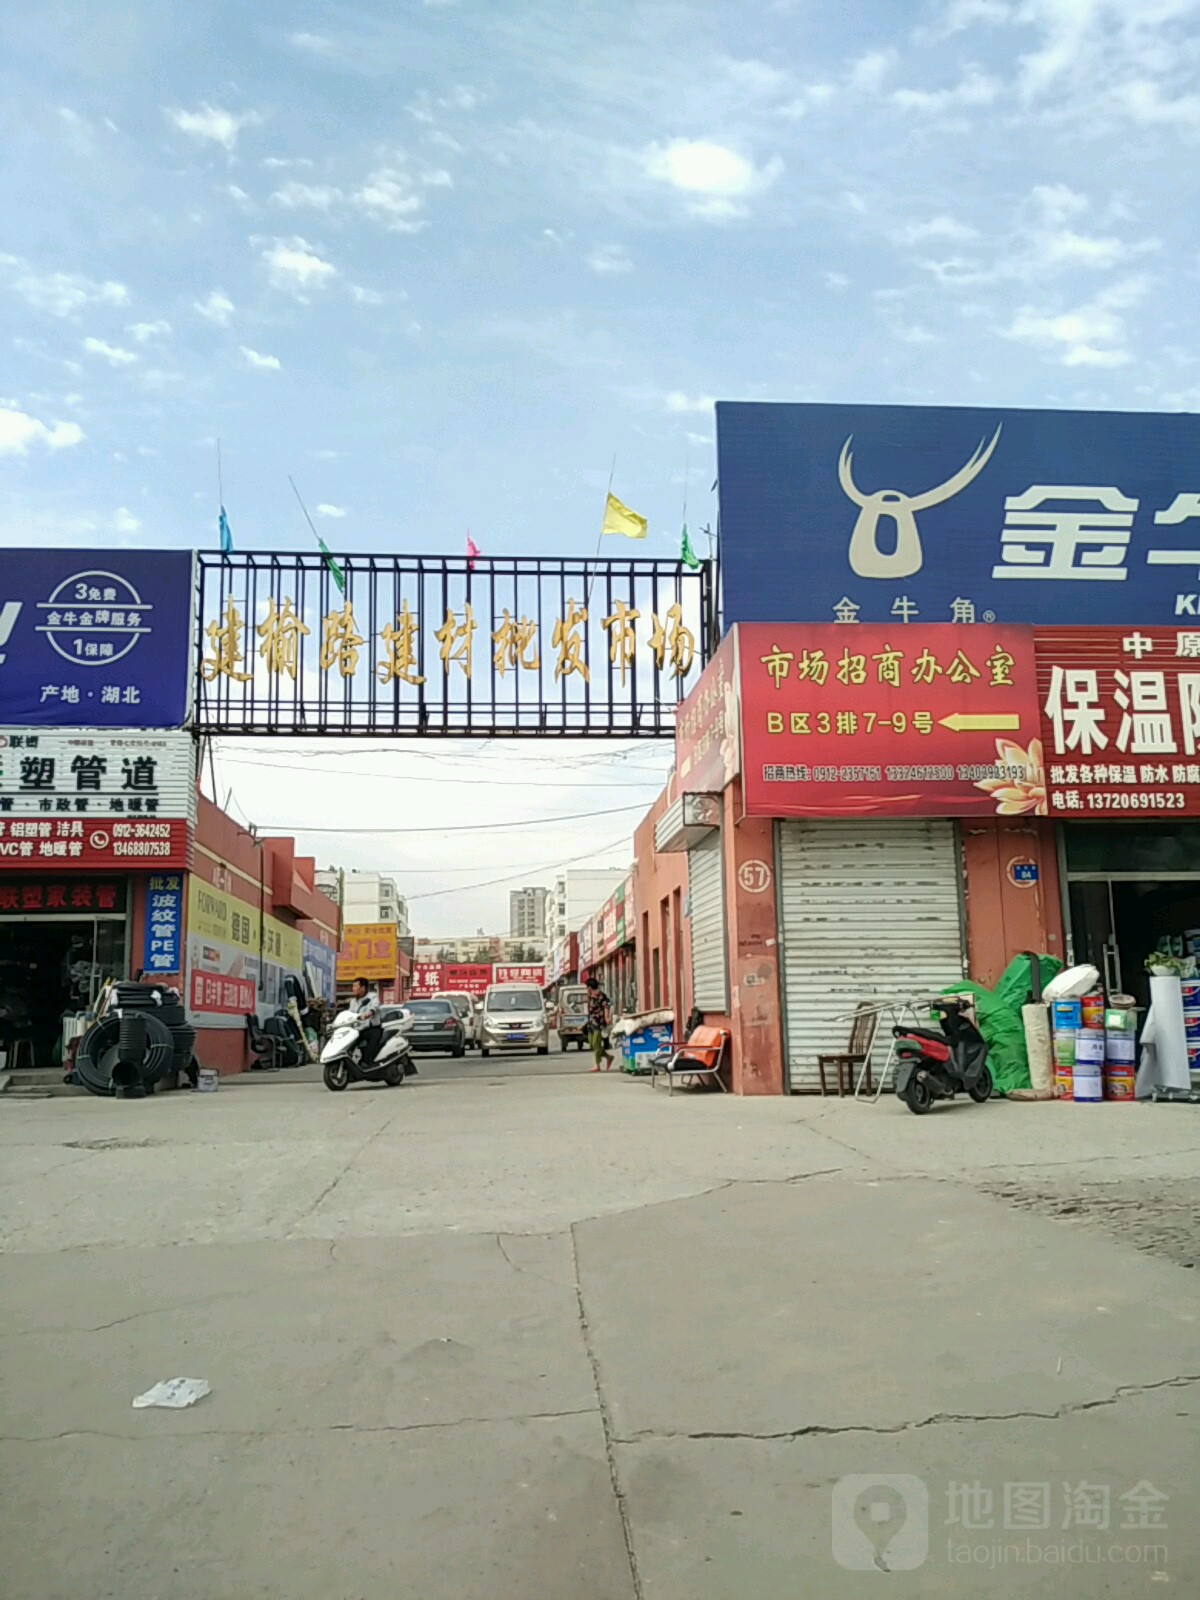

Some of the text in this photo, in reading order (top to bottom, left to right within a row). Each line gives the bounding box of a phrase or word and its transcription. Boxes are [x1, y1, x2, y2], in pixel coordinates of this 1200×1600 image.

[75, 583, 117, 601] 3免费
[833, 596, 976, 623] 金牛角
[1175, 594, 1200, 615] K
[47, 610, 142, 626] 金牛金牌服务
[73, 639, 114, 656] 1保障
[200, 594, 696, 687] 建榆路建材批发市场
[760, 644, 1016, 688] 市场招商办公室
[766, 711, 934, 735] B区3排7-9号
[0, 755, 158, 790] 塑管道
[1050, 764, 1137, 784] 批发各种保温
[1140, 765, 1169, 784] 防水
[10, 822, 52, 837] 铝塑管
[56, 821, 84, 837] 洁具
[39, 841, 83, 856] 地暖管
[149, 877, 180, 890] 批发
[743, 866, 765, 885] 57
